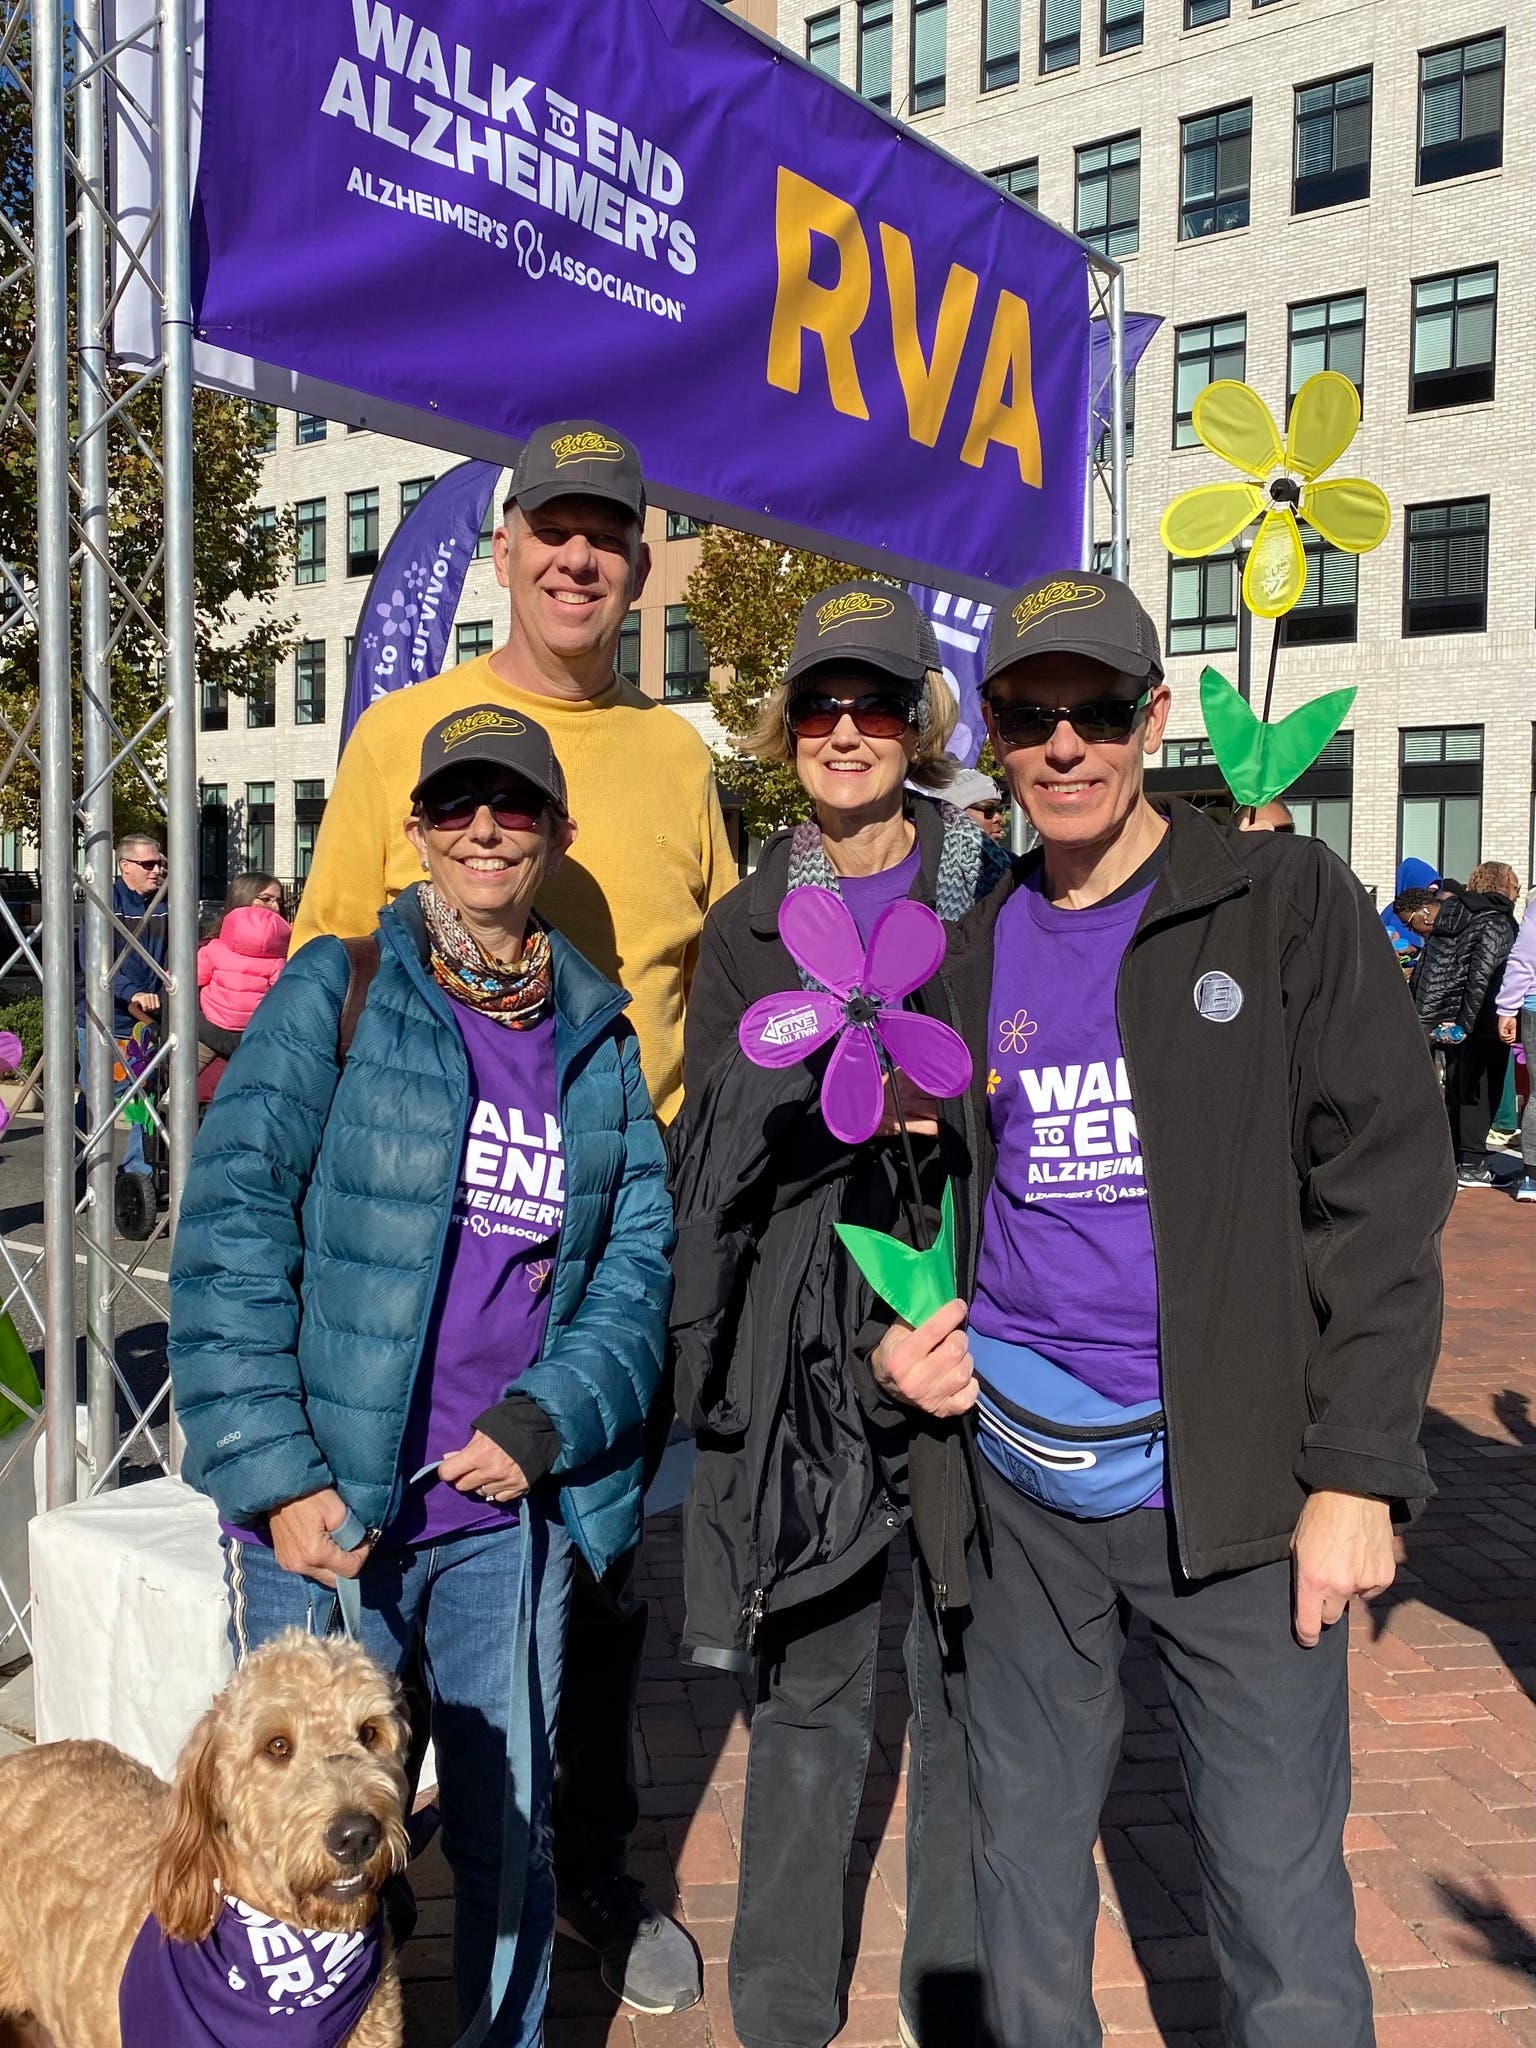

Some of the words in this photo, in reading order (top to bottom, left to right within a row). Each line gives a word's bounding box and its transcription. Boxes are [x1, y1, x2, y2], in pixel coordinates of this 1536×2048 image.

[320, 57, 697, 276] ALZHEIMER'S
[351, 0, 537, 135] WALK
[549, 105, 576, 138] TO
[585, 110, 685, 206] END
[347, 167, 508, 249] ALZHEIMER'S
[767, 166, 1043, 489] RVA
[375, 645, 398, 675] to
[411, 538, 456, 673] survivor.
[1034, 1127, 1065, 1145] TO
